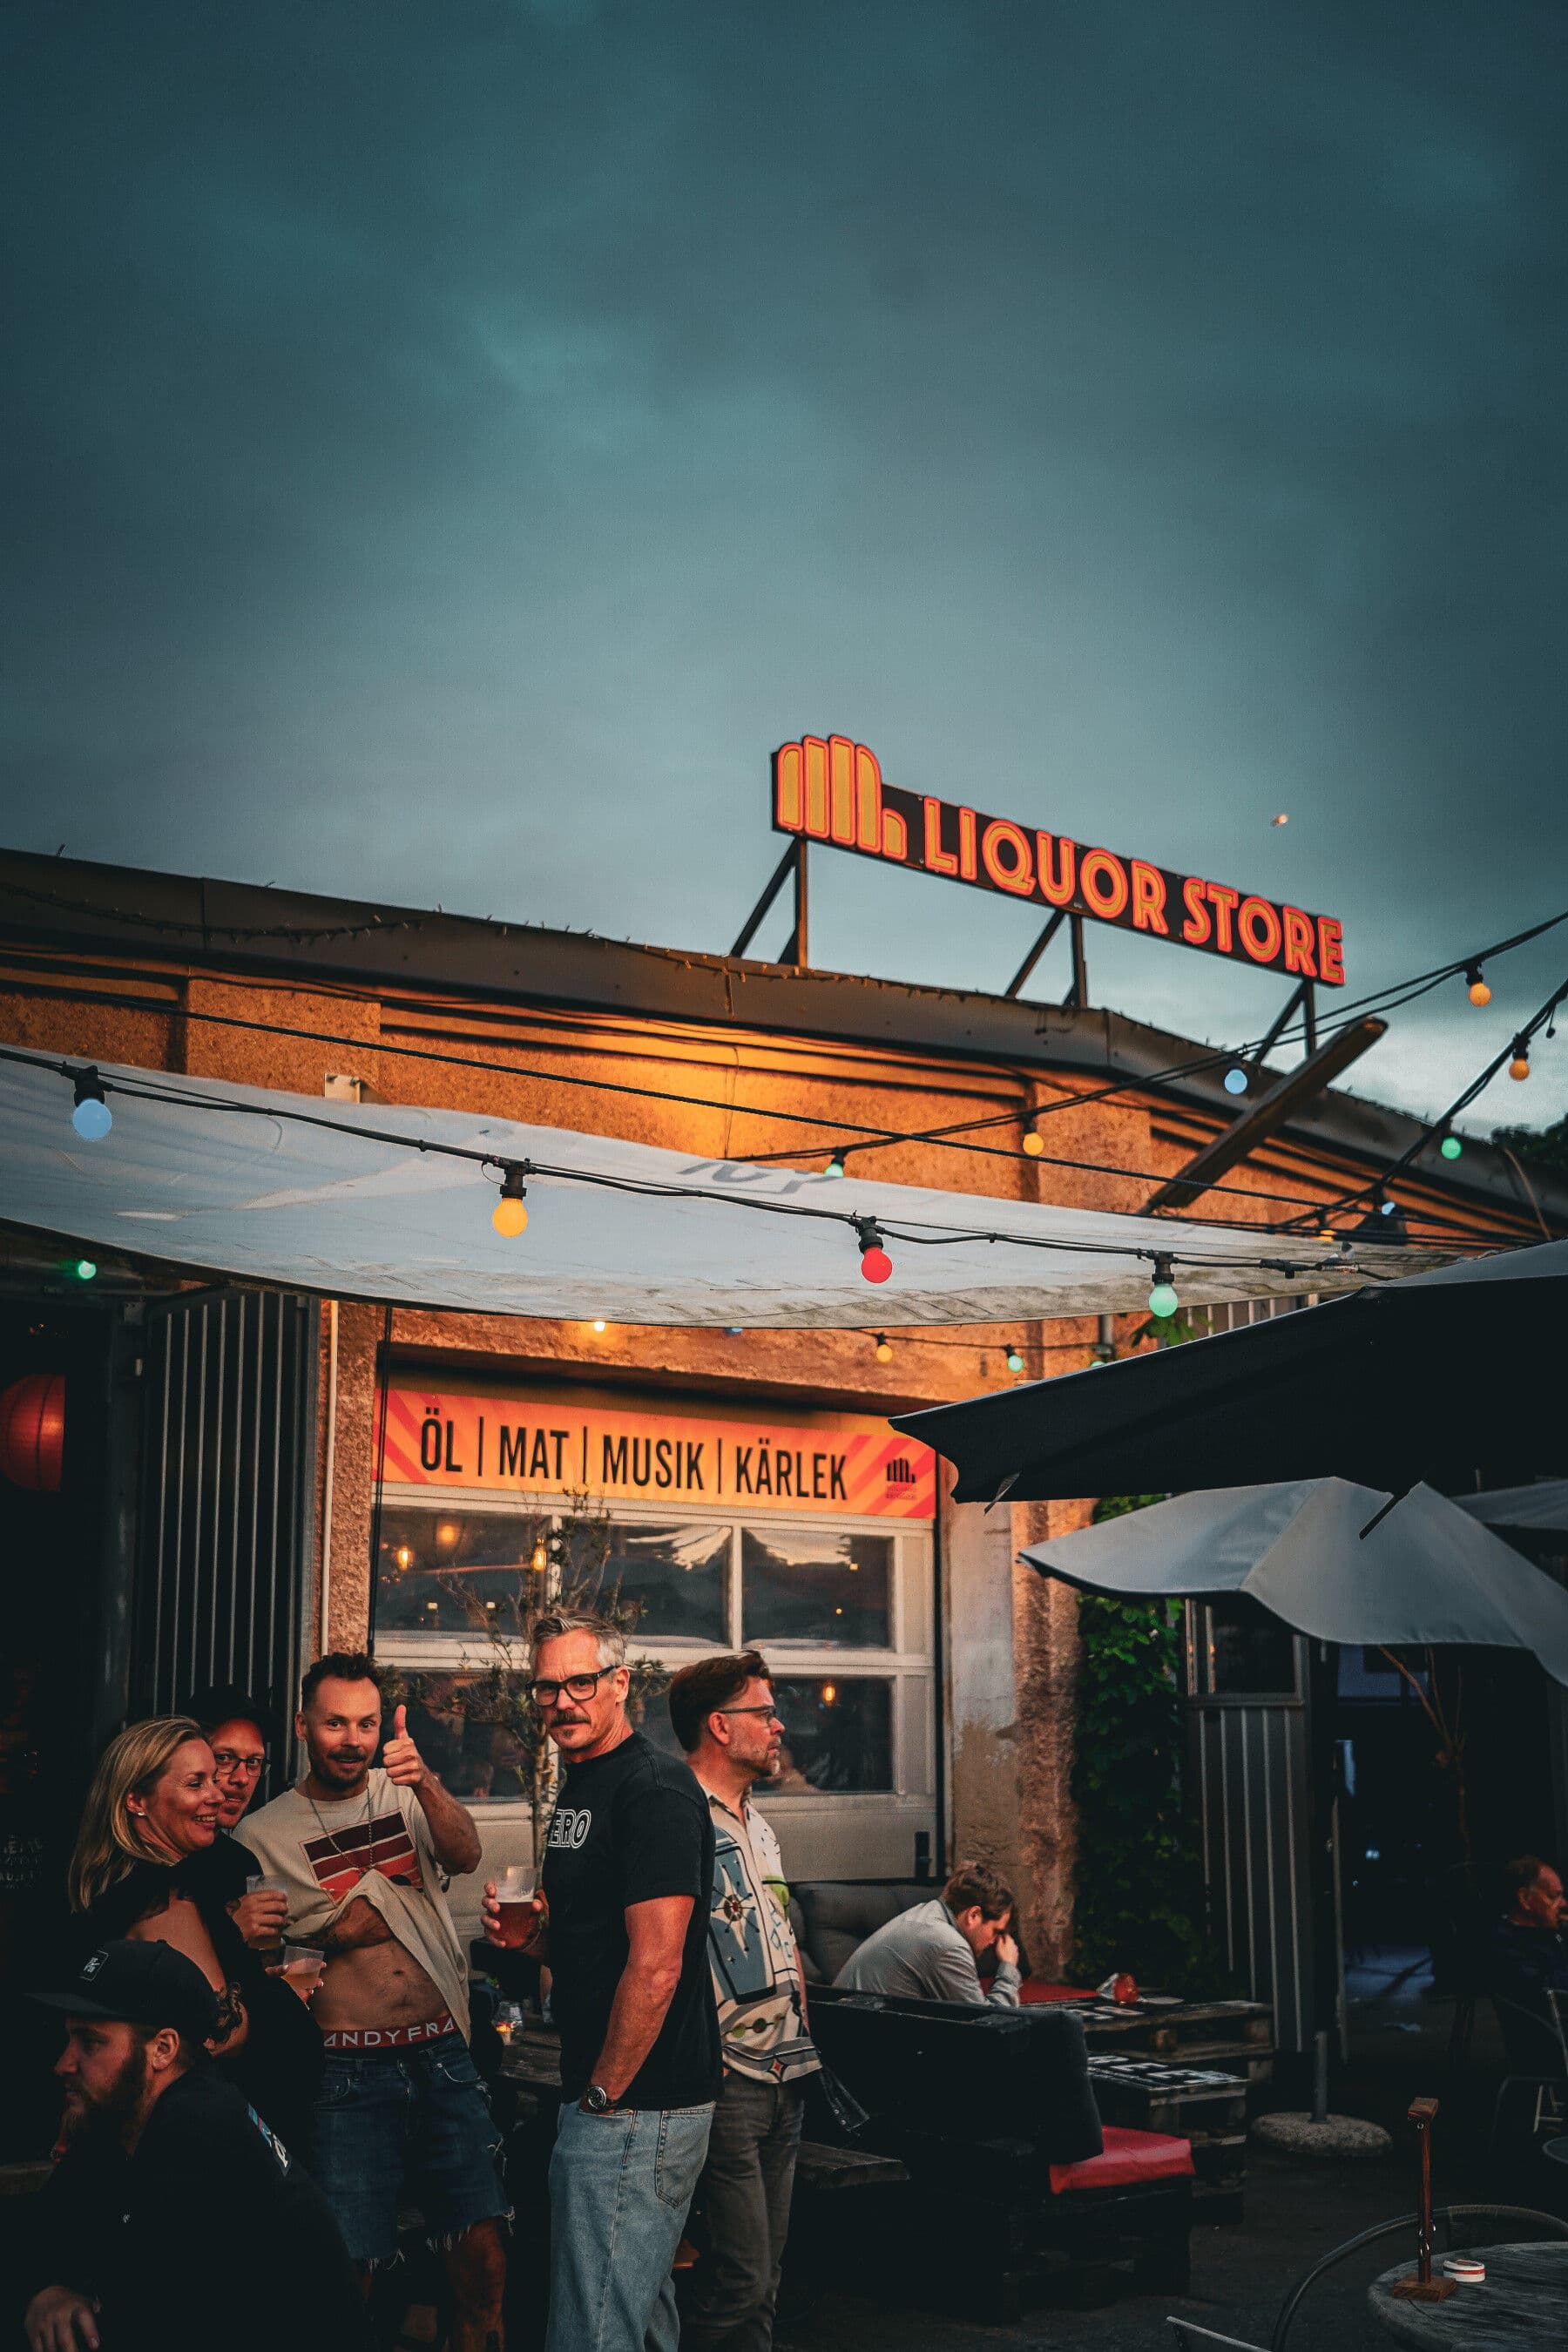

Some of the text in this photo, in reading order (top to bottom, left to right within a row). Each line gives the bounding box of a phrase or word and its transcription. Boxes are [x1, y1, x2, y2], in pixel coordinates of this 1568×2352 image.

[923, 796, 1345, 985] LIQUOR STORE
[421, 1407, 848, 1501] ÖL MAT MUSIK KÄRLEK
